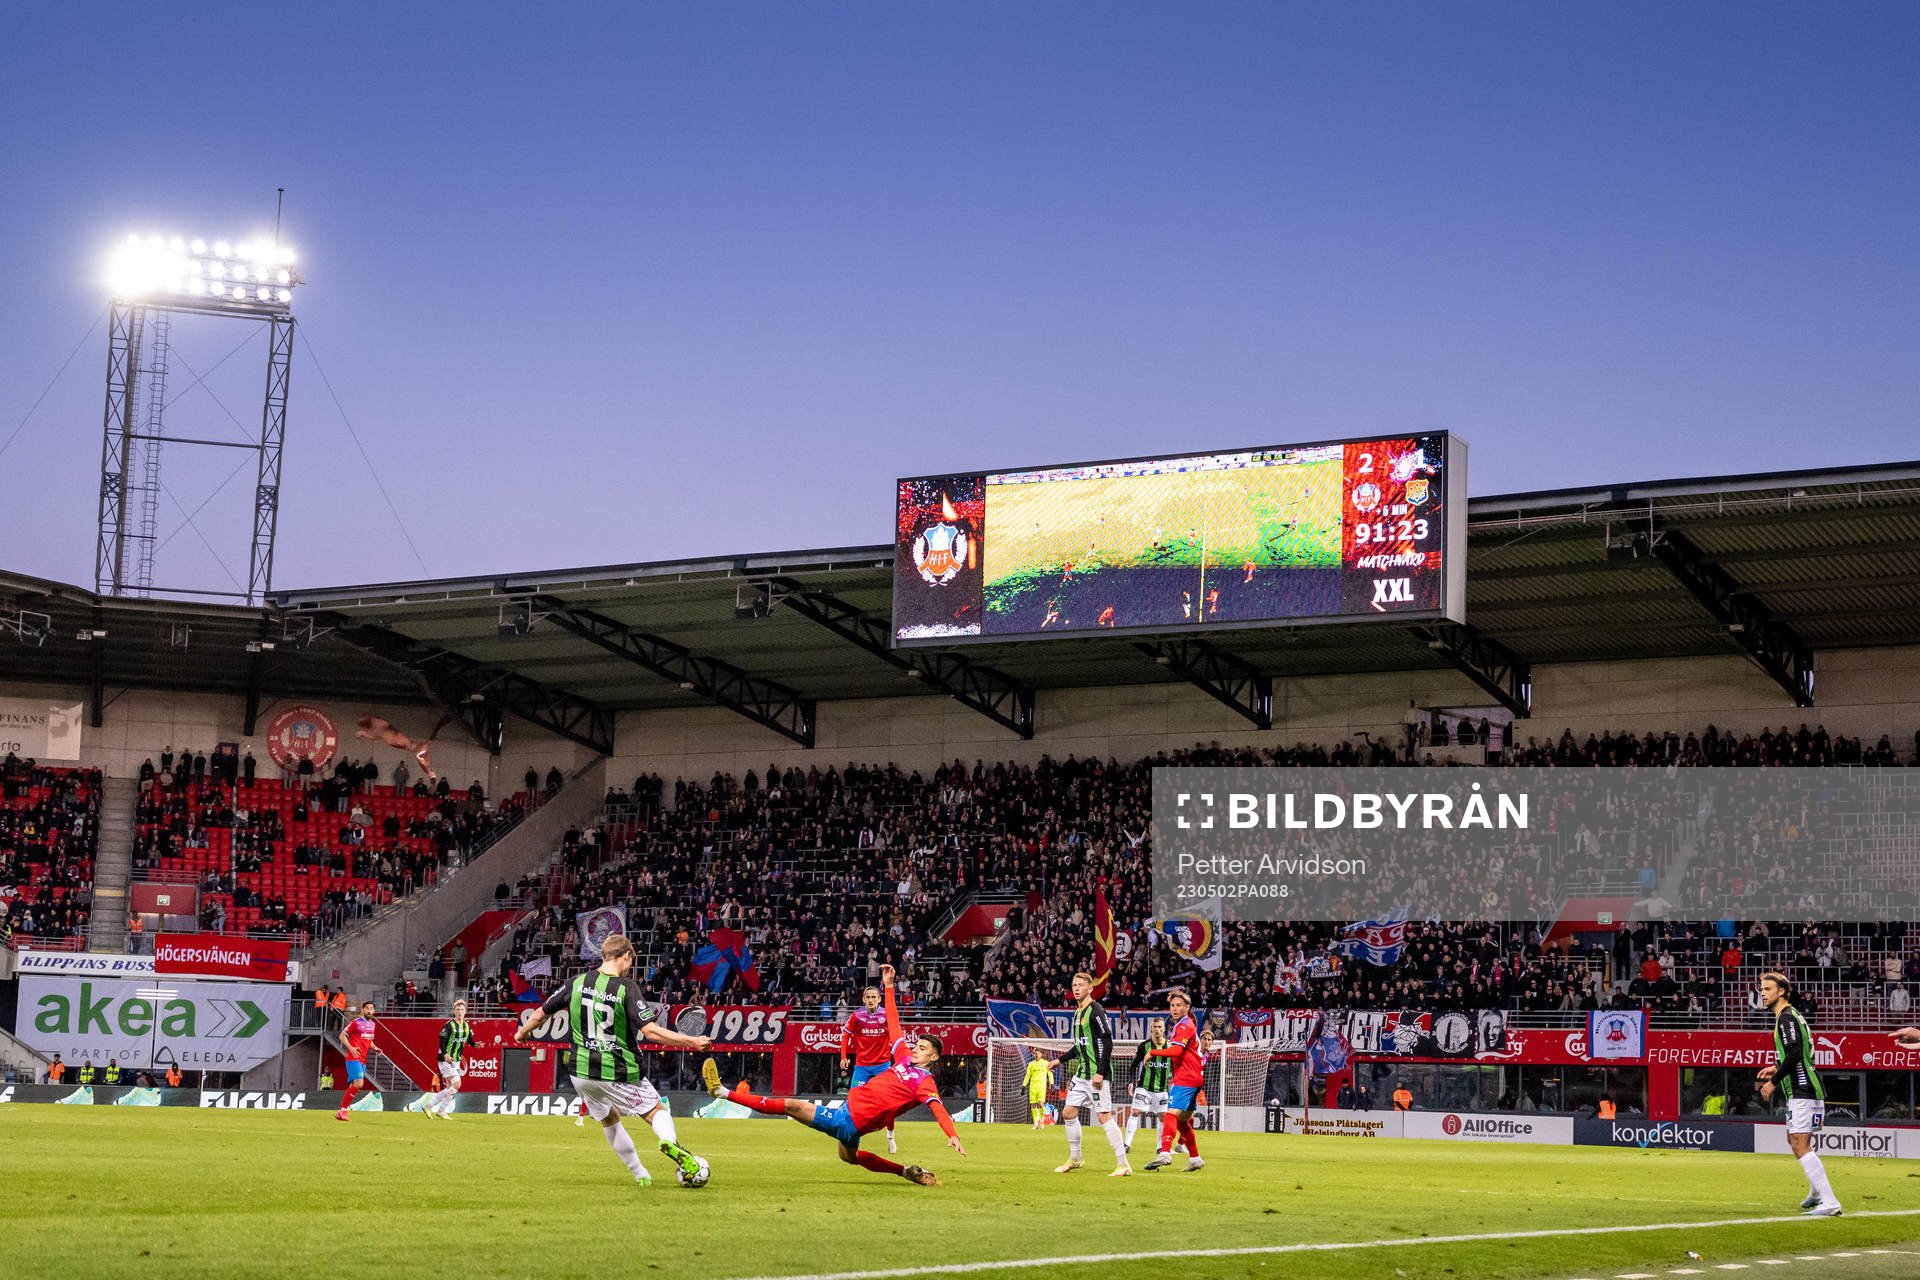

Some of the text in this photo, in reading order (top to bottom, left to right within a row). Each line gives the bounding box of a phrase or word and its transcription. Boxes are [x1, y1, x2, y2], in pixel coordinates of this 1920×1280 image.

[1359, 453, 1374, 473] 2
[1392, 504, 1408, 515] MIN
[1355, 518, 1429, 543] 91:23
[1373, 578, 1414, 603] XXL
[21, 956, 108, 970] KLIPPANS
[156, 944, 251, 966] HÖGERSVÄNGEN
[34, 983, 196, 1037] akea
[581, 998, 617, 1042] 12
[709, 1010, 787, 1042] 1985
[801, 1025, 851, 1047] Carlsber
[71, 1048, 236, 1063] PART OF ELEDA
[469, 1057, 498, 1070] beat
[1648, 1048, 1778, 1064] FOREVER FASTE
[1872, 1051, 1920, 1067] FORE
[1336, 1119, 1384, 1130] Plåtslageri
[1463, 1119, 1533, 1134] AllOffice
[1612, 1121, 1714, 1144] kondektor
[1809, 1131, 1892, 1152] granitor
